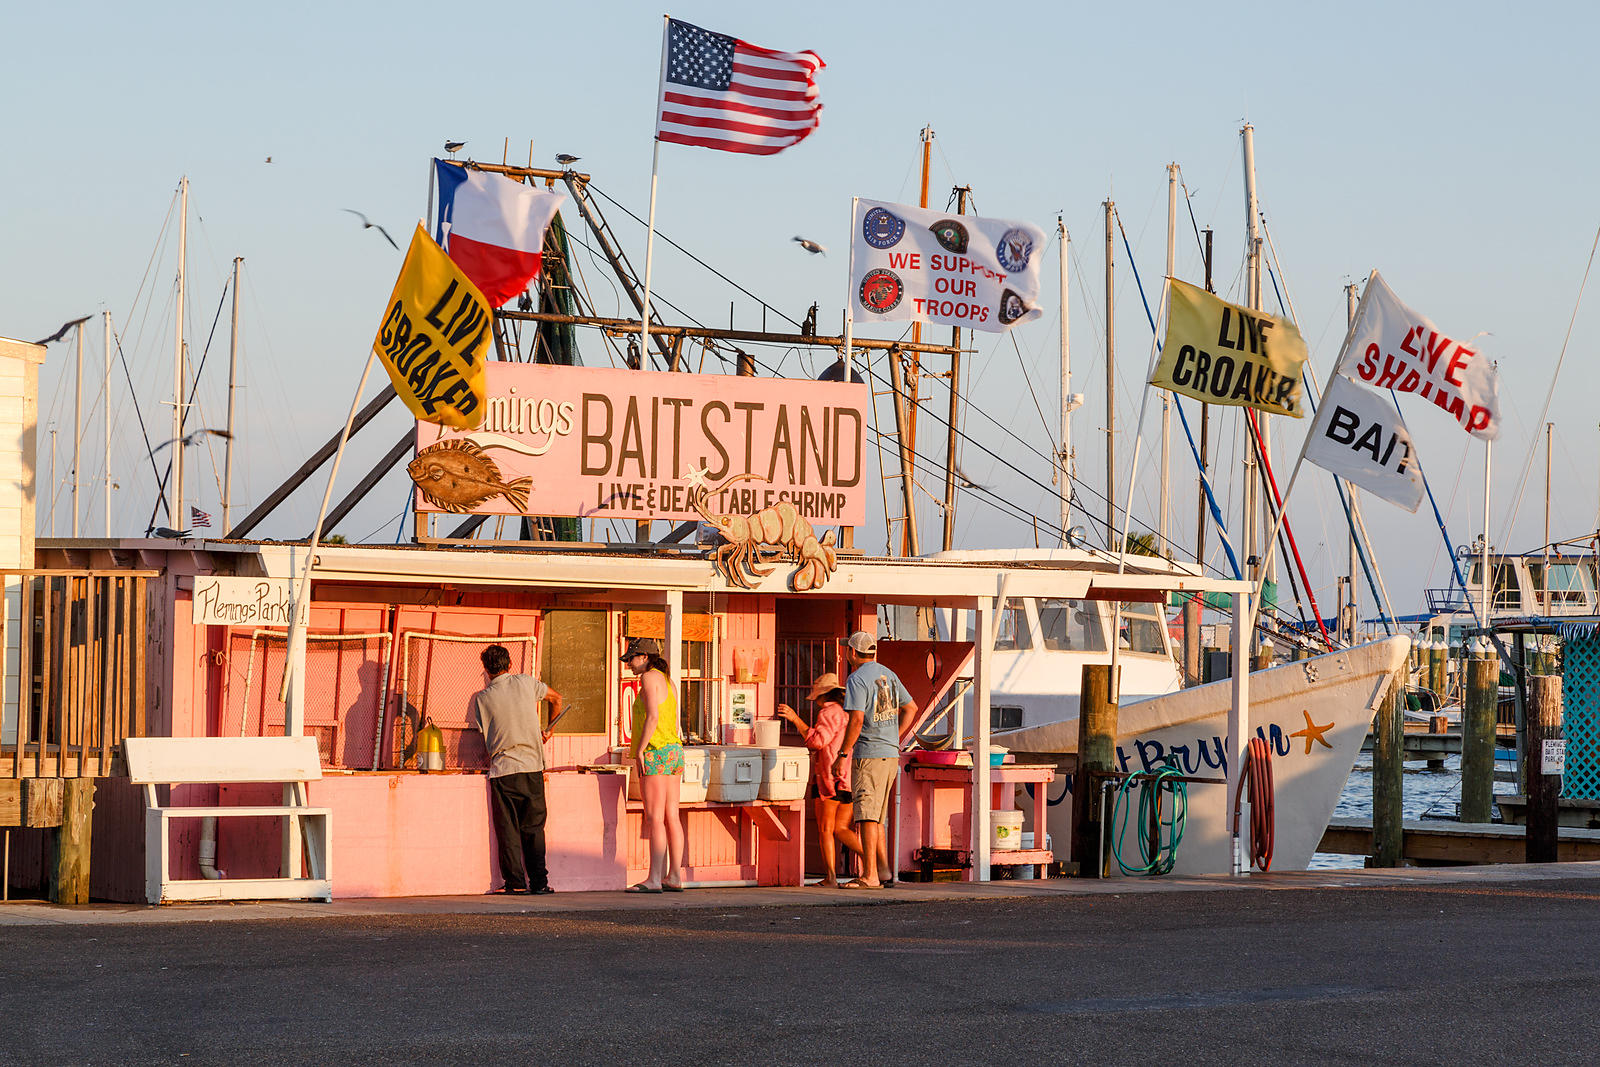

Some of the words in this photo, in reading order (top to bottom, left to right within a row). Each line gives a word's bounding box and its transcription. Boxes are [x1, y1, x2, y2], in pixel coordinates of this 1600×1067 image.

[889, 253, 921, 270] WE
[913, 298, 989, 322] TROOPS
[935, 278, 977, 298] OUR
[1218, 306, 1275, 359] LIVE
[1400, 325, 1476, 388] LIVE
[437, 386, 576, 456] mings
[1325, 405, 1411, 475] BAIT
[598, 482, 645, 511] LIVE
[716, 488, 775, 515] TABLE
[198, 580, 257, 624] Flemings
[1134, 723, 1291, 780] Bryn
